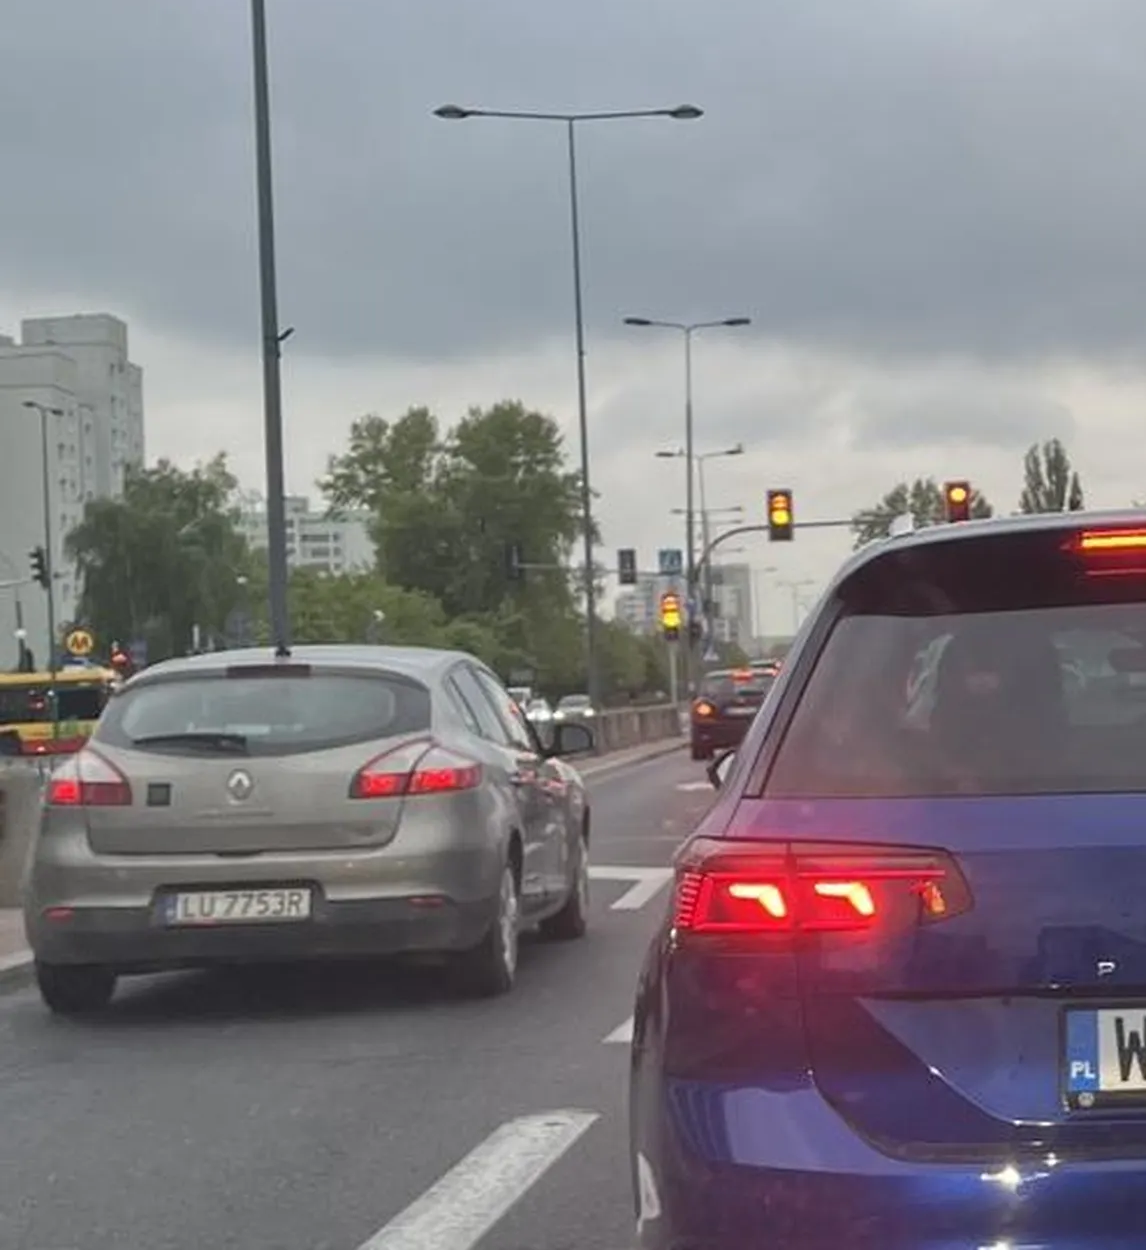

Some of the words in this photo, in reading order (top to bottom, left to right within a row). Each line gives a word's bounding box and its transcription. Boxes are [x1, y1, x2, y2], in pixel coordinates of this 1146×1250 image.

[184, 895, 214, 918] LU
[224, 892, 302, 917] 7753R
[1071, 1061, 1095, 1078] PL
